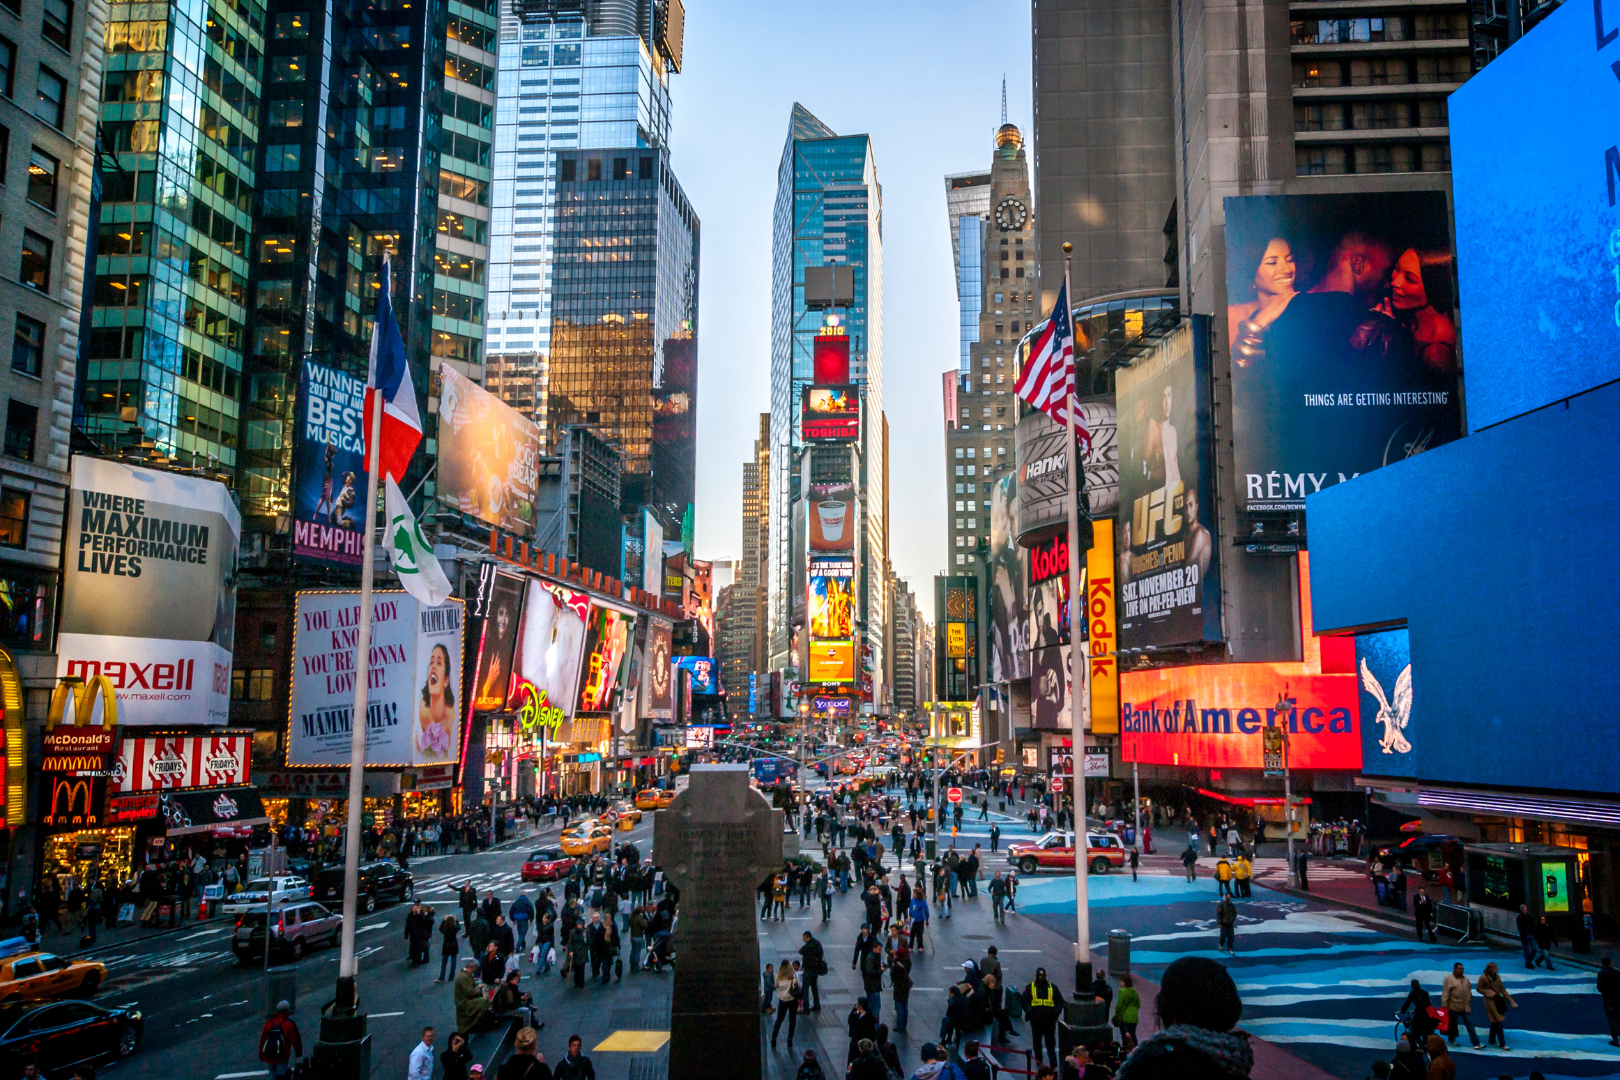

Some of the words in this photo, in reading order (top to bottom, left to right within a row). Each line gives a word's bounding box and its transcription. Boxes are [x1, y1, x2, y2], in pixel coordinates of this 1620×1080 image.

[820, 326, 844, 336] 2010
[310, 382, 328, 399] 2010
[330, 388, 348, 406] TONY
[1304, 394, 1334, 406] THINGS
[1338, 393, 1354, 406] ARE
[1356, 392, 1390, 406] GETTING
[1393, 392, 1448, 406] INTERESTING
[804, 427, 858, 438] TOSHIBA
[513, 439, 536, 470] YOGI
[512, 458, 538, 491] BEAR
[1036, 472, 1062, 485] driving
[1245, 470, 1328, 498] RÉMY
[82, 490, 145, 516] WHERE
[1132, 479, 1184, 547] UFC
[81, 508, 209, 548] MAXIMUM
[78, 550, 142, 578] LIVES
[79, 533, 206, 564] PERFORMANCE
[1032, 531, 1070, 582] Koda
[1132, 550, 1158, 575] HUGHES
[1163, 541, 1185, 566] PENN
[1122, 582, 1138, 603] SAT.
[1138, 568, 1184, 599] NOVEMBER
[1185, 564, 1198, 586] 20
[304, 610, 331, 632] YOU
[336, 600, 398, 628] ALRADY
[1126, 600, 1138, 618] LIVE
[1139, 598, 1148, 615] ON
[1148, 586, 1196, 612] PAY-PER-VIEW
[420, 608, 446, 633] MAMMA
[446, 608, 460, 630] MIA!
[1090, 577, 1114, 678] Kodak
[950, 636, 964, 644] LION
[950, 644, 964, 654] KING
[66, 658, 194, 690] maxell
[302, 650, 354, 676] YOU'RE
[368, 644, 406, 667] ONNA
[116, 692, 190, 701] ww.maxell.com
[1124, 701, 1162, 733] Bank
[1164, 700, 1184, 733] of
[1184, 698, 1352, 734] America
[44, 734, 110, 744] McDonald's
